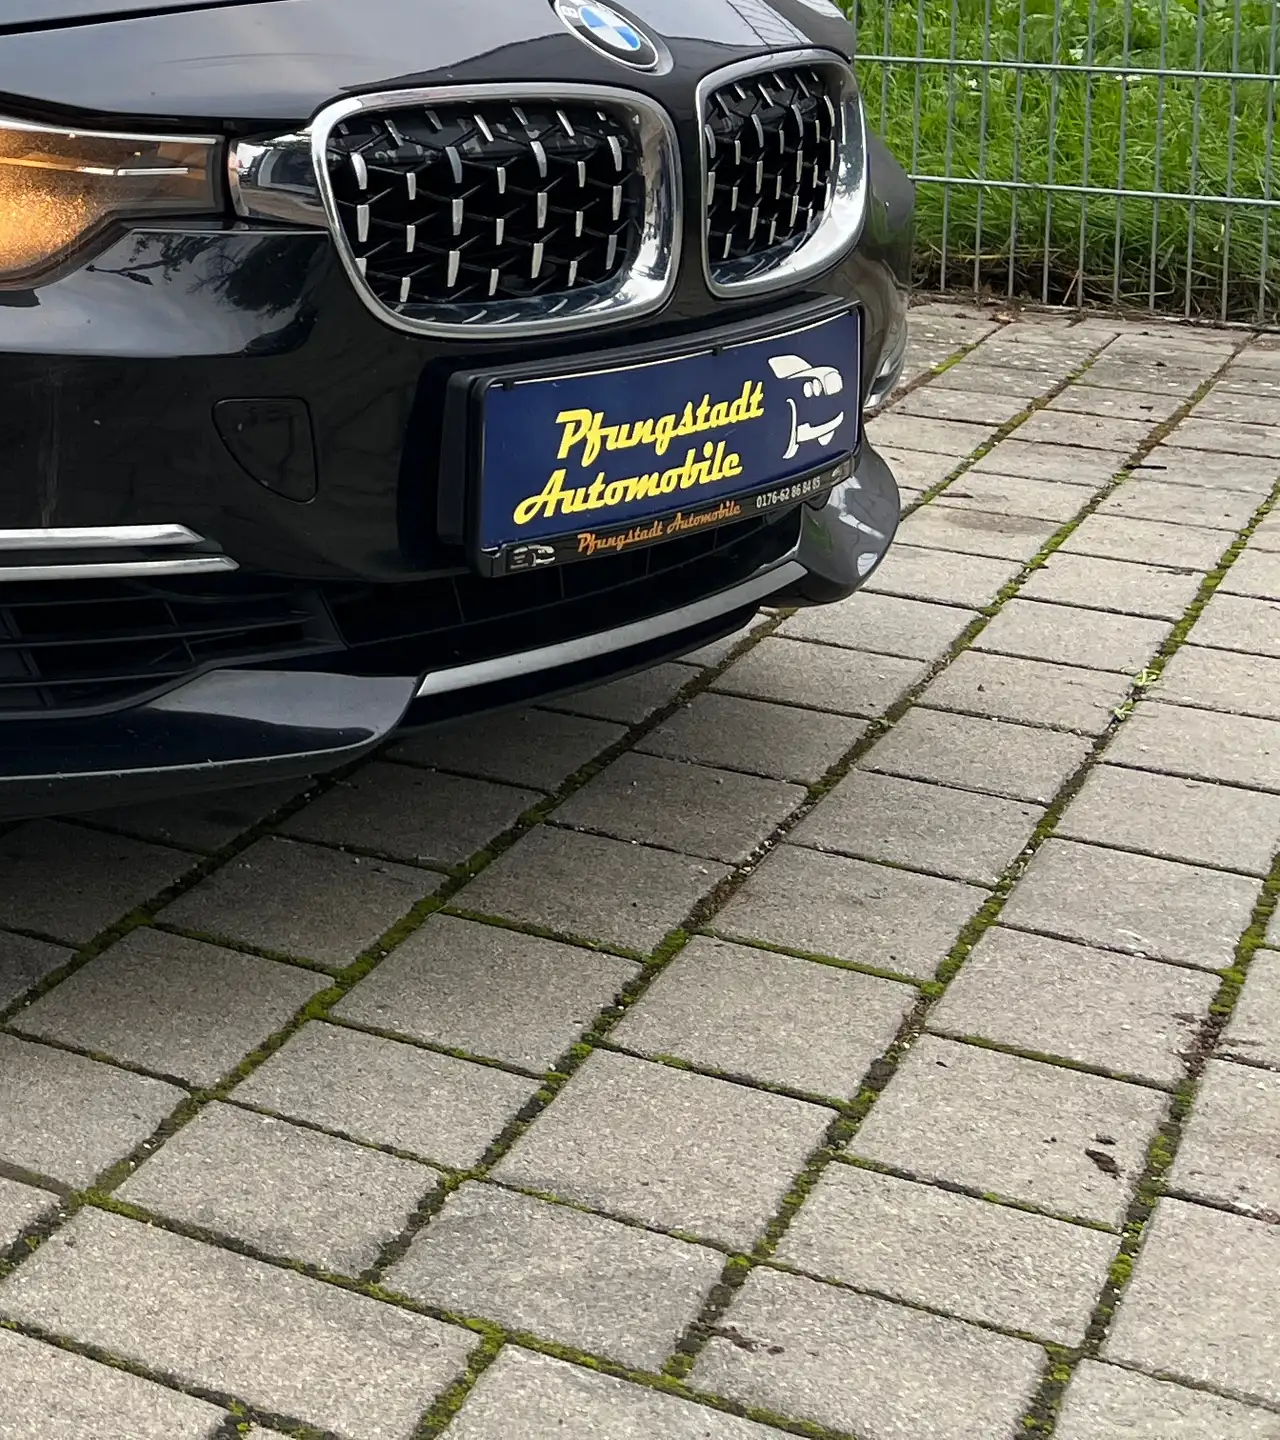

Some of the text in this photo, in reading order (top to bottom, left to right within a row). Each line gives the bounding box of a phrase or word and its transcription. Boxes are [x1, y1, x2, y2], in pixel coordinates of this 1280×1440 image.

[556, 380, 765, 467] Pfungstadt
[513, 440, 743, 525] Automobile
[576, 520, 664, 555] Pfungstadt
[666, 500, 742, 534] Automobile
[756, 487, 790, 509] 0176-62
